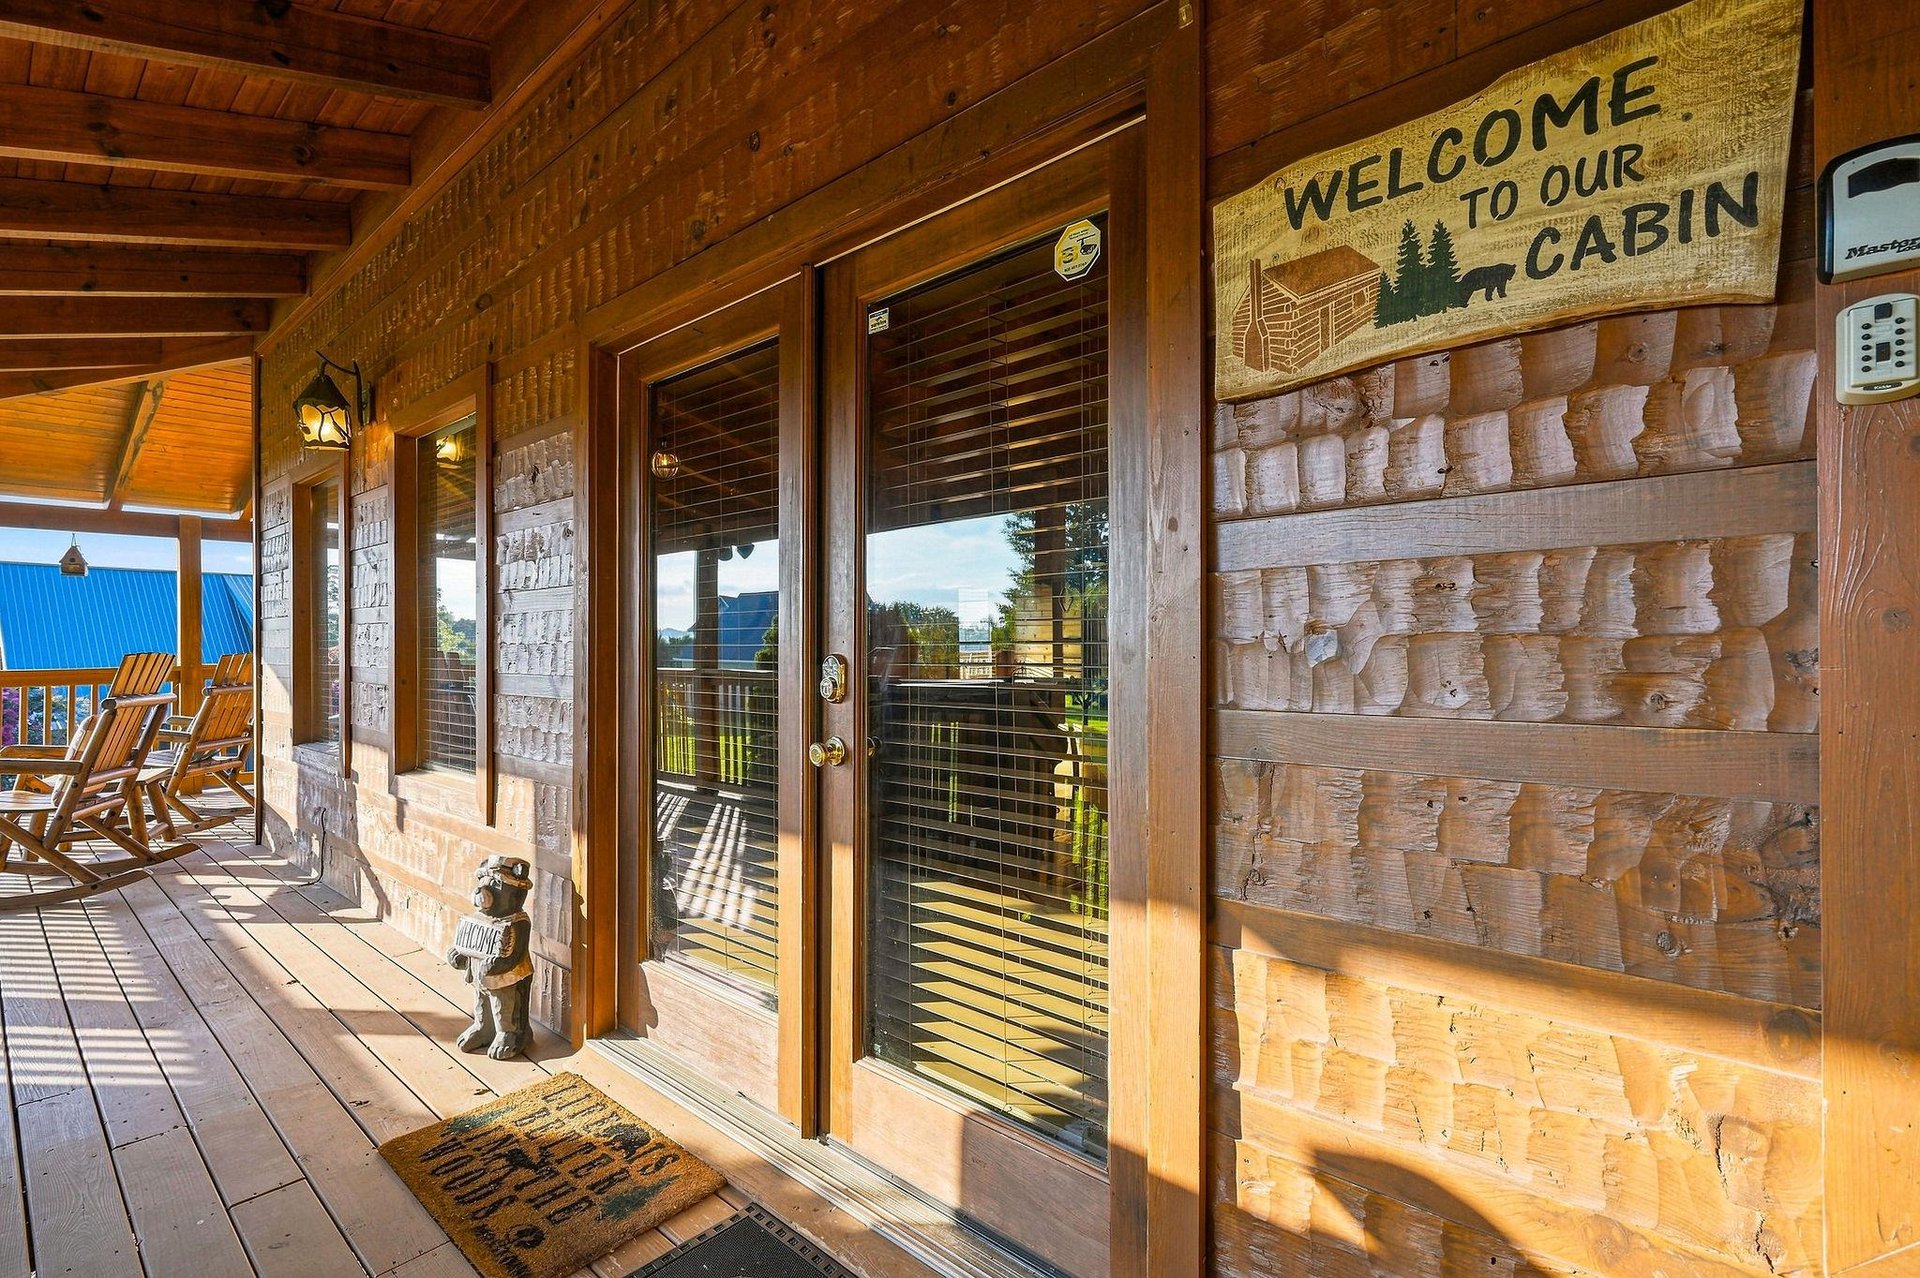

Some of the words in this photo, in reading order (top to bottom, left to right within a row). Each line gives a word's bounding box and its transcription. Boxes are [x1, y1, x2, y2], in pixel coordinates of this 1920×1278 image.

[1284, 55, 1661, 231] WELCOME
[1460, 180, 1519, 229] TO
[1540, 143, 1645, 206] OUR
[1525, 170, 1759, 280] CABIN
[456, 919, 502, 955] WELCOME
